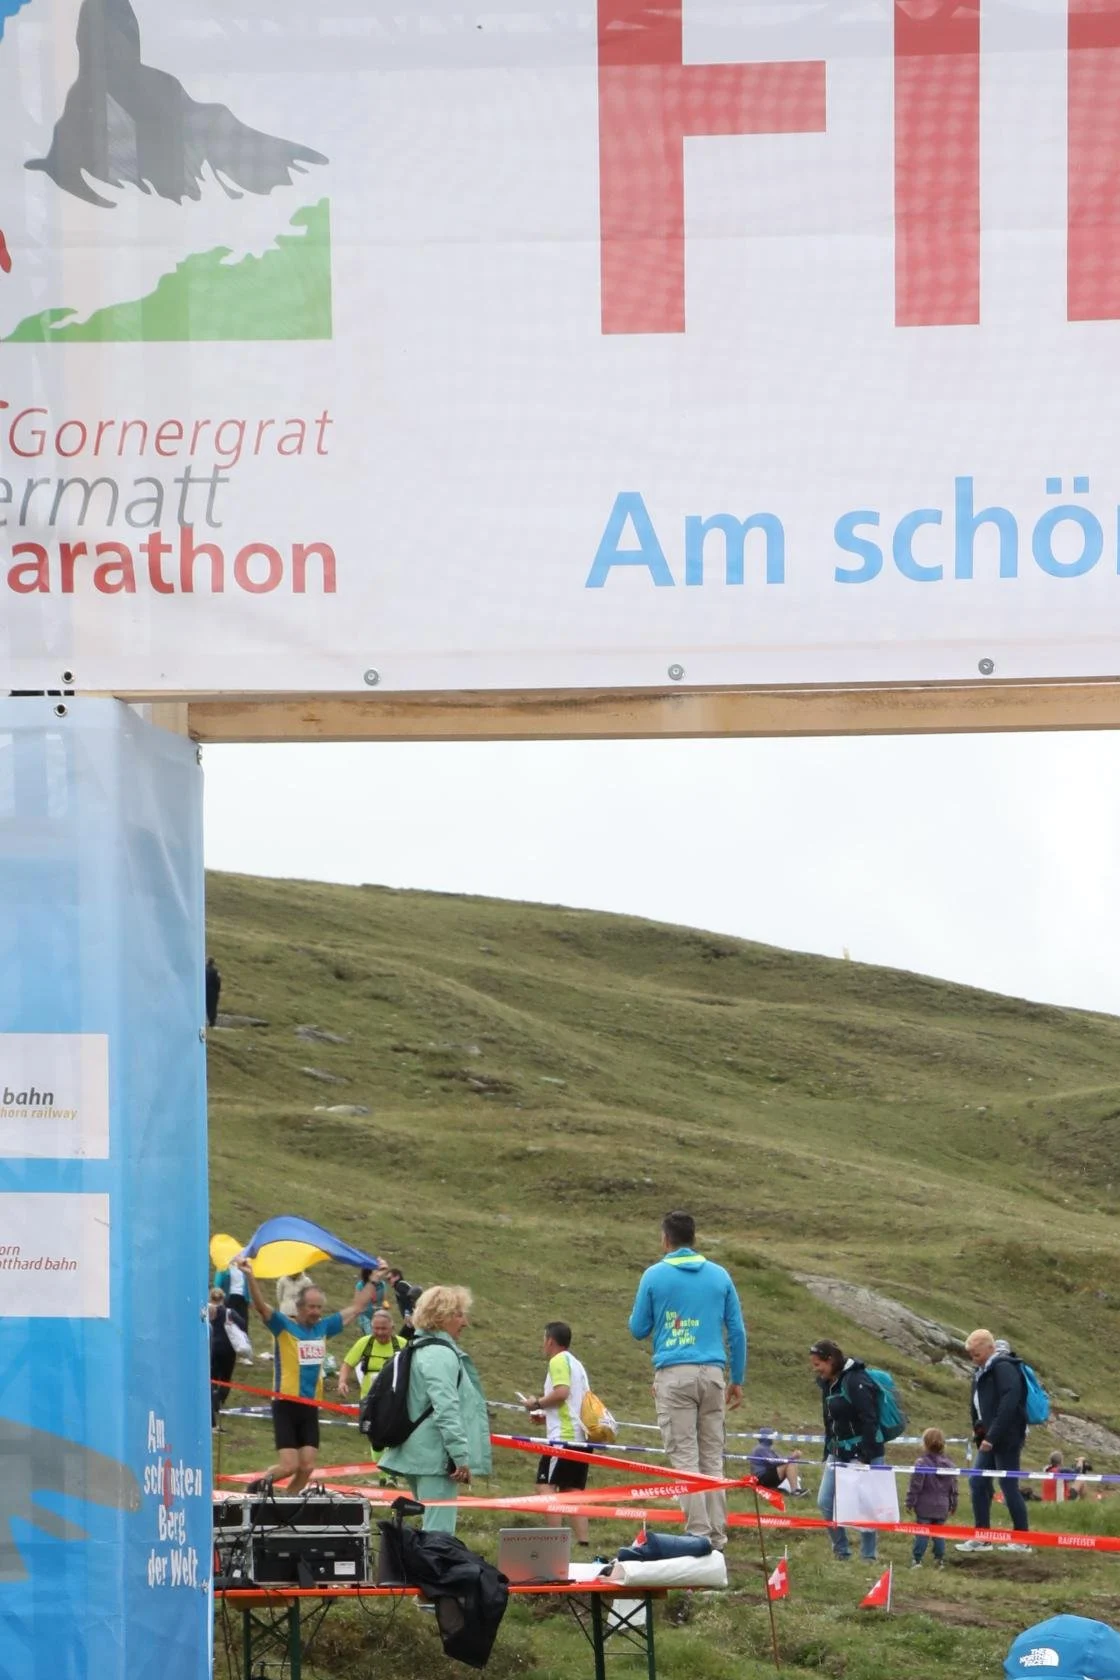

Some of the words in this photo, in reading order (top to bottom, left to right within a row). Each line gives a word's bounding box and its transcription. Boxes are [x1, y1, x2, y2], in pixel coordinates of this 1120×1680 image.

[8, 408, 333, 470] Gornergrat
[585, 491, 785, 588] Am
[3, 1087, 54, 1105] bahn
[31, 1107, 77, 1120] railway
[0, 1257, 43, 1270] tthard
[44, 1257, 77, 1270] bahn
[147, 1411, 165, 1453] Am
[630, 1485, 689, 1498] RAIFFEISEN
[158, 1504, 186, 1545] Berg
[1057, 1536, 1096, 1547] RAIFFEISEN
[148, 1548, 168, 1589] der
[170, 1547, 198, 1588] Welt
